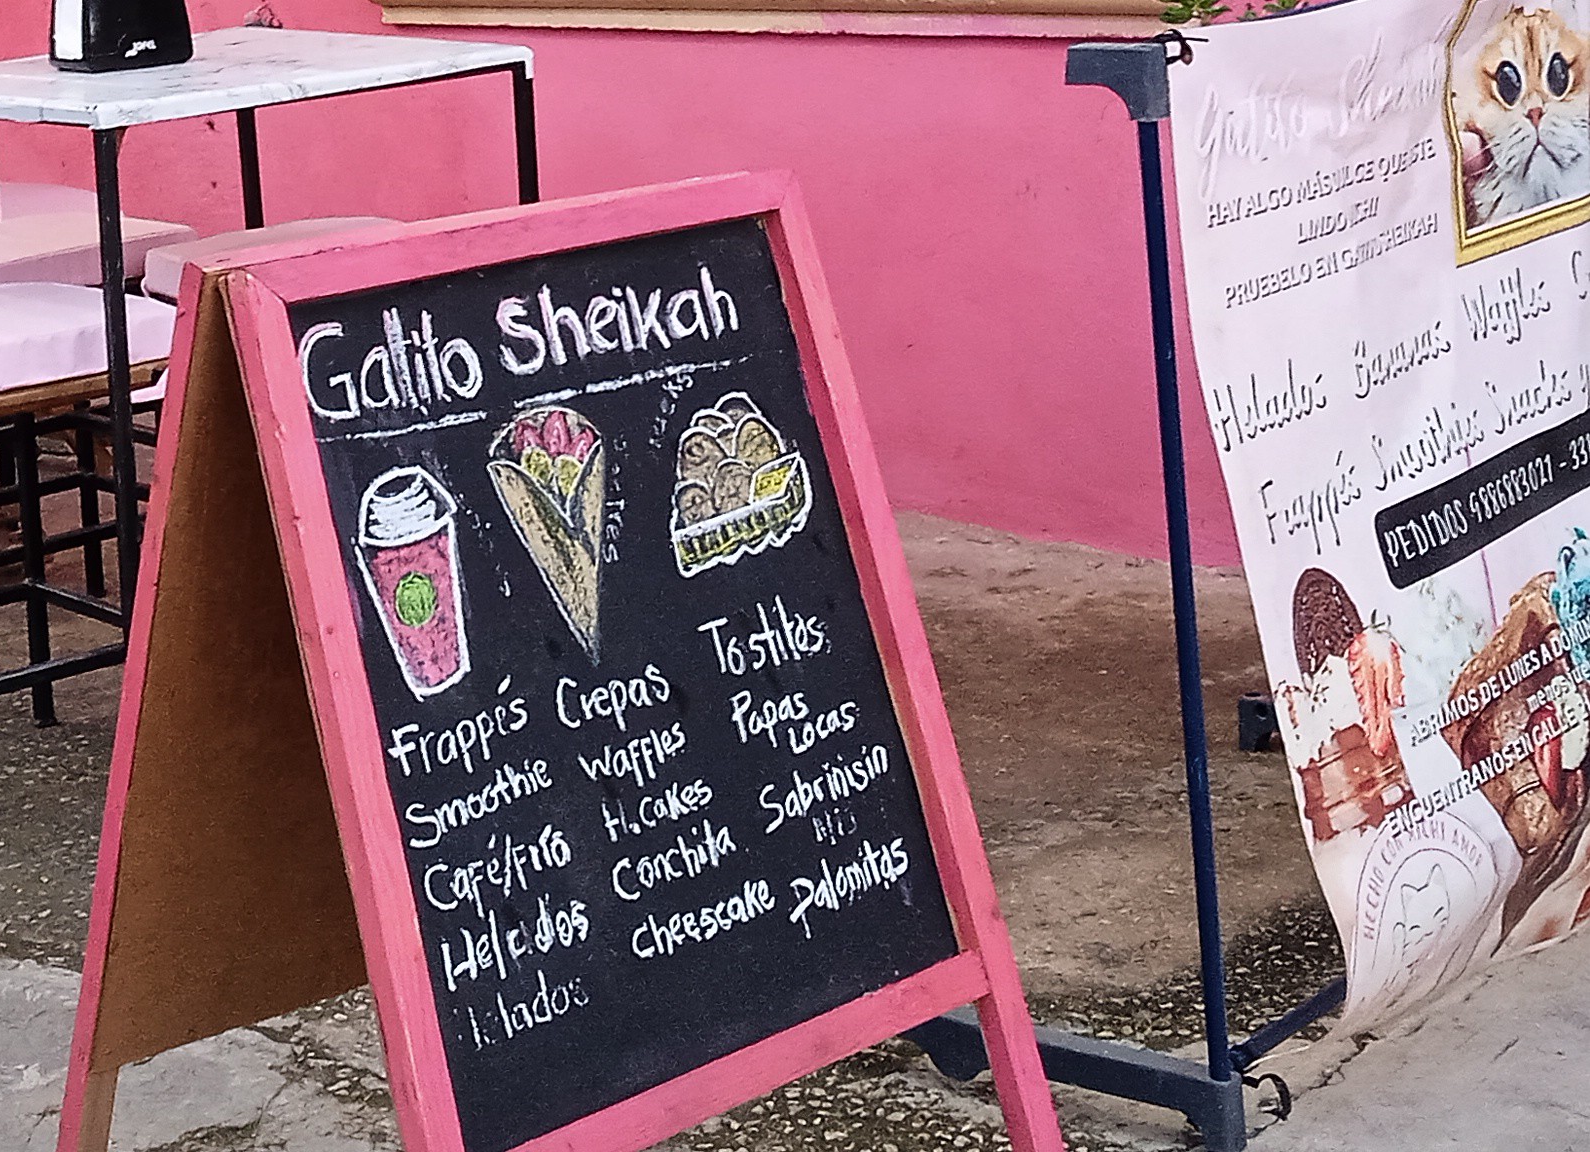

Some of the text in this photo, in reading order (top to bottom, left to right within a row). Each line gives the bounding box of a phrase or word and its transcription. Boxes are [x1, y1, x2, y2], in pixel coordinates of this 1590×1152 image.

[1207, 197, 1241, 228] HAY
[1244, 186, 1292, 218] ALGO
[297, 264, 740, 422] Gatito Sheikah
[1383, 499, 1469, 569] PEDIDOS
[387, 664, 670, 777] Frappés Crepas
[729, 690, 810, 748] Papas
[1409, 688, 1481, 747] ABRIMOS
[1478, 677, 1503, 705] DE
[1500, 649, 1542, 692] LUNES
[1532, 703, 1582, 748] CALLE
[405, 758, 553, 848] Smoothie
[612, 819, 737, 901] Conchita
[789, 837, 909, 939] Palomitas
